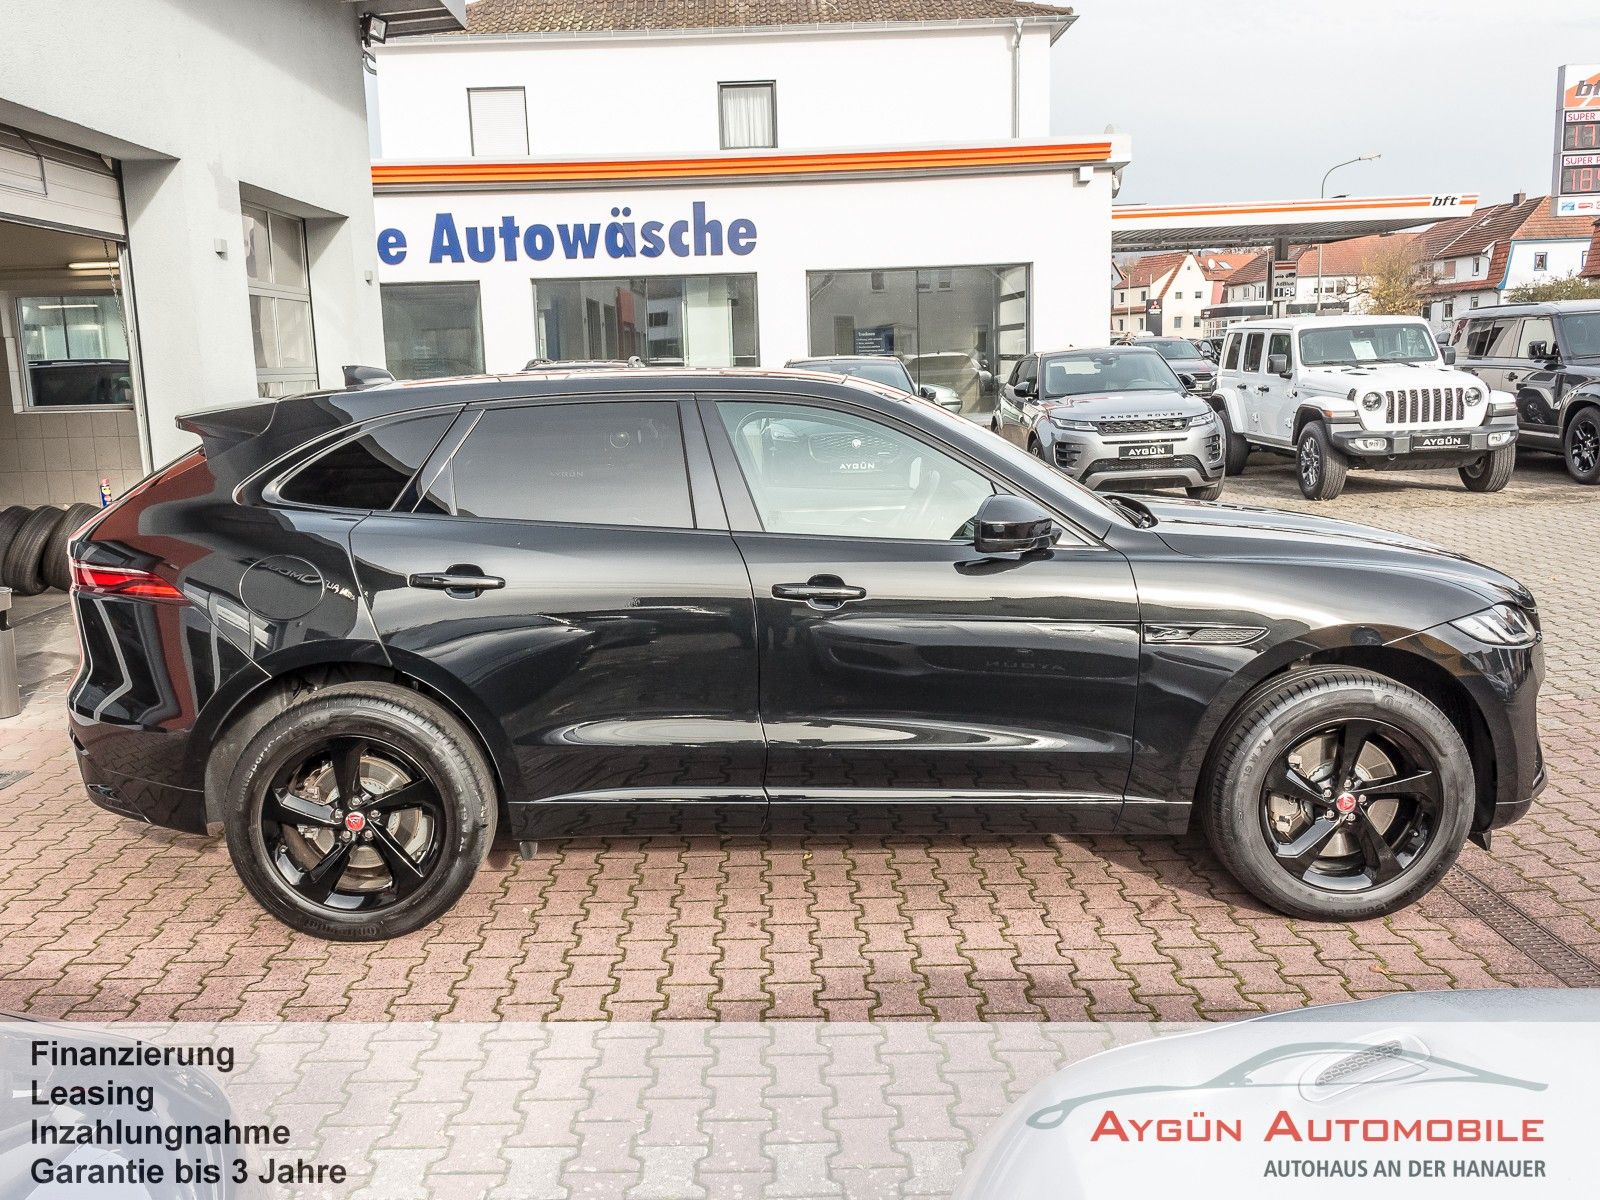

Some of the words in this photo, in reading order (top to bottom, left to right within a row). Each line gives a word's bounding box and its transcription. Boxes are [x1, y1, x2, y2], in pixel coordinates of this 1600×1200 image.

[1575, 80, 1600, 96] bf
[1567, 112, 1596, 121] SUPER
[1565, 156, 1593, 165] SUPER
[1432, 195, 1458, 206] bft
[377, 228, 407, 265] e
[429, 201, 757, 264] Autowäsche
